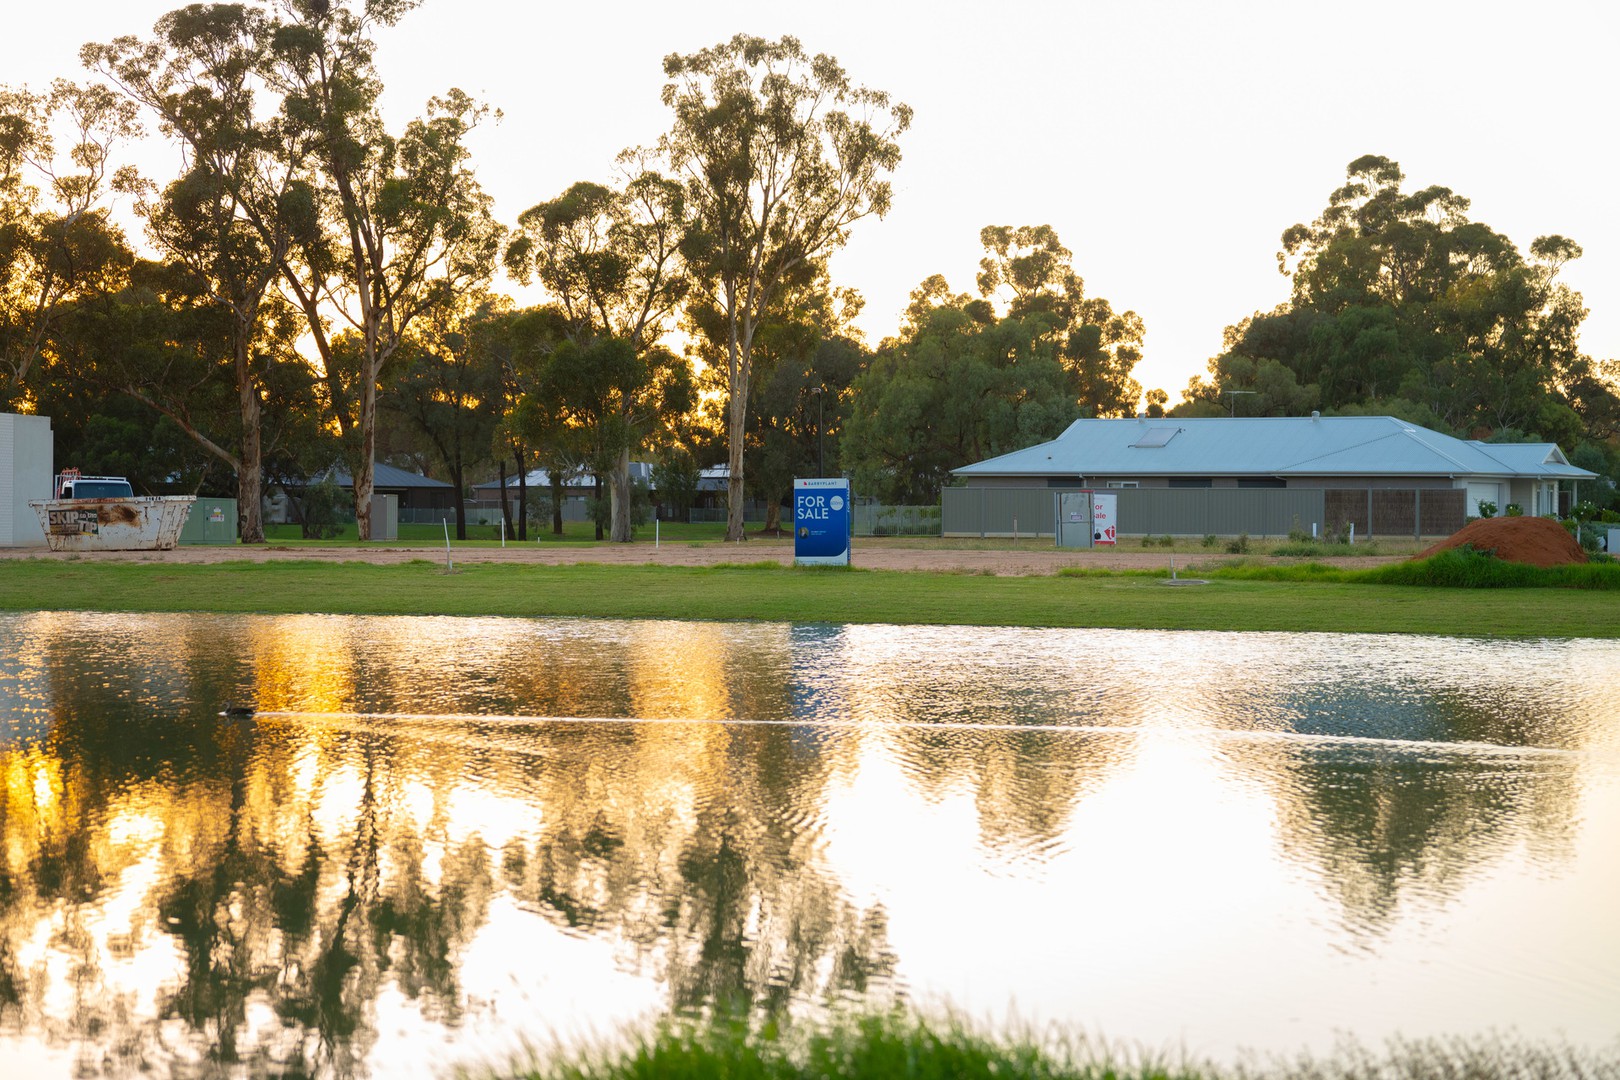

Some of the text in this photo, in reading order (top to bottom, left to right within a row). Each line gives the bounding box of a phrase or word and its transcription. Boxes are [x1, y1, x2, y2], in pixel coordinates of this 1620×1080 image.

[797, 496, 825, 507] FOR
[49, 511, 79, 525] SKIP
[797, 508, 829, 520] SALE
[77, 520, 98, 532] TIP
